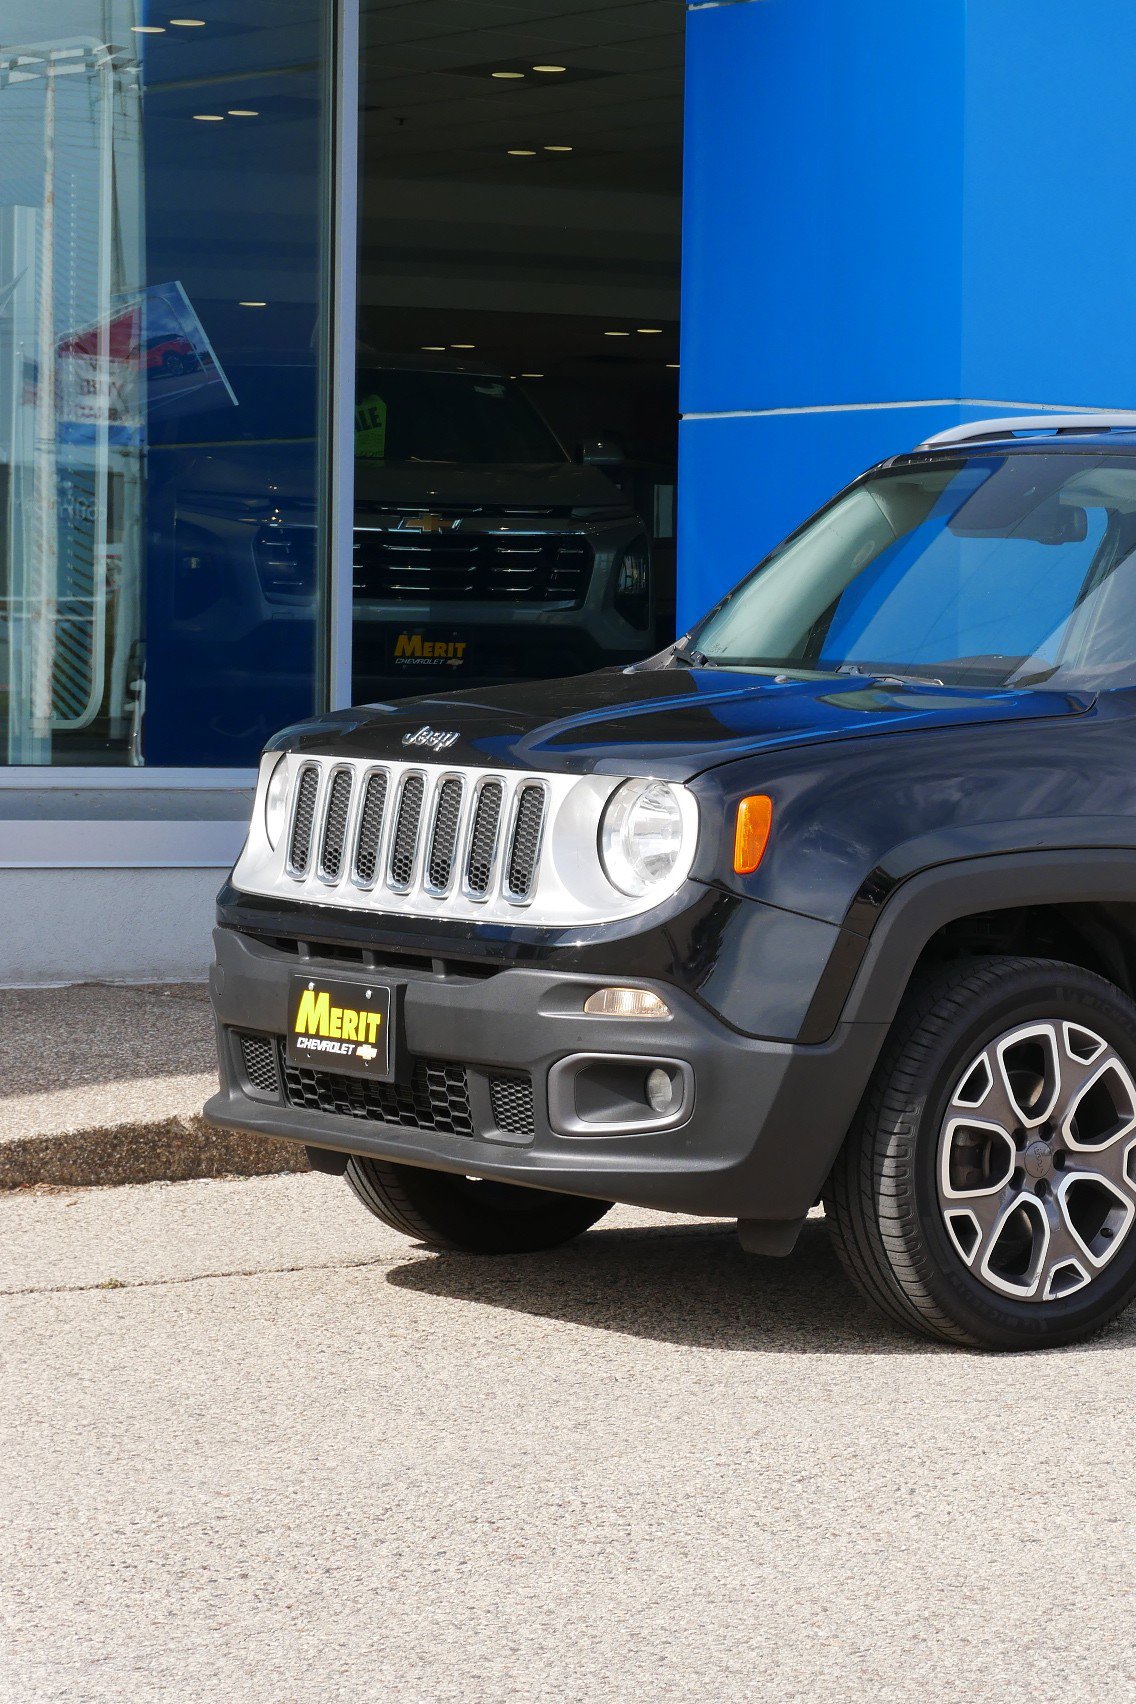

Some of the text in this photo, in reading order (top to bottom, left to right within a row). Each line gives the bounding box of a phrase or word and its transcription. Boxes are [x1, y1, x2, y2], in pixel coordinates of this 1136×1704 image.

[394, 635, 466, 657] MERIT
[402, 725, 460, 751] Jeep
[295, 989, 381, 1043] MERIT
[296, 1037, 355, 1055] CHEVROLET
